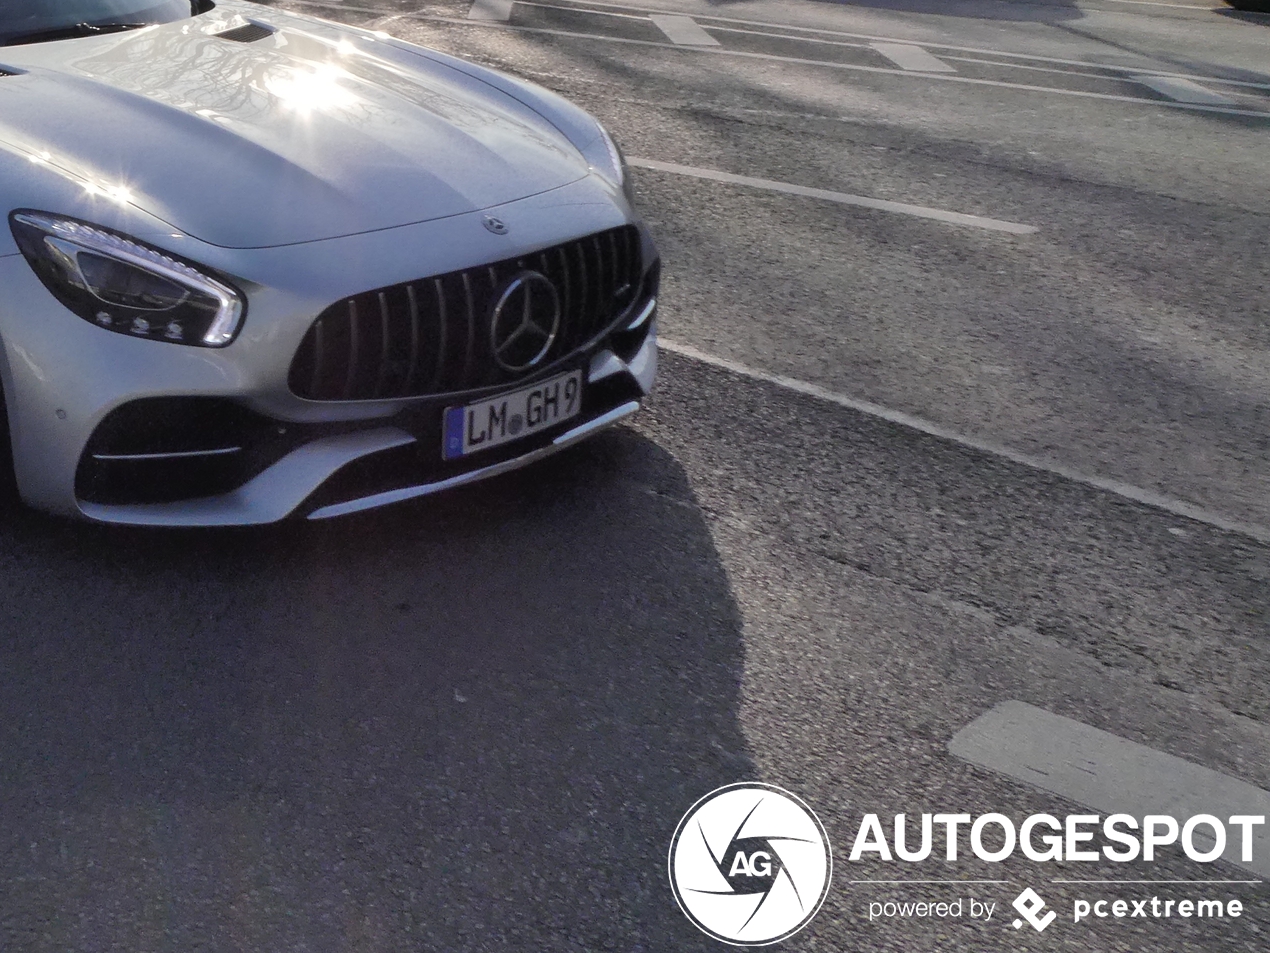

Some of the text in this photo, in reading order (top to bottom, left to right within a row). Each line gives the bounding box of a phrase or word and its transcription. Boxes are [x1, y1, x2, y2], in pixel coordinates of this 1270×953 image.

[468, 377, 578, 446] LM GH 9
